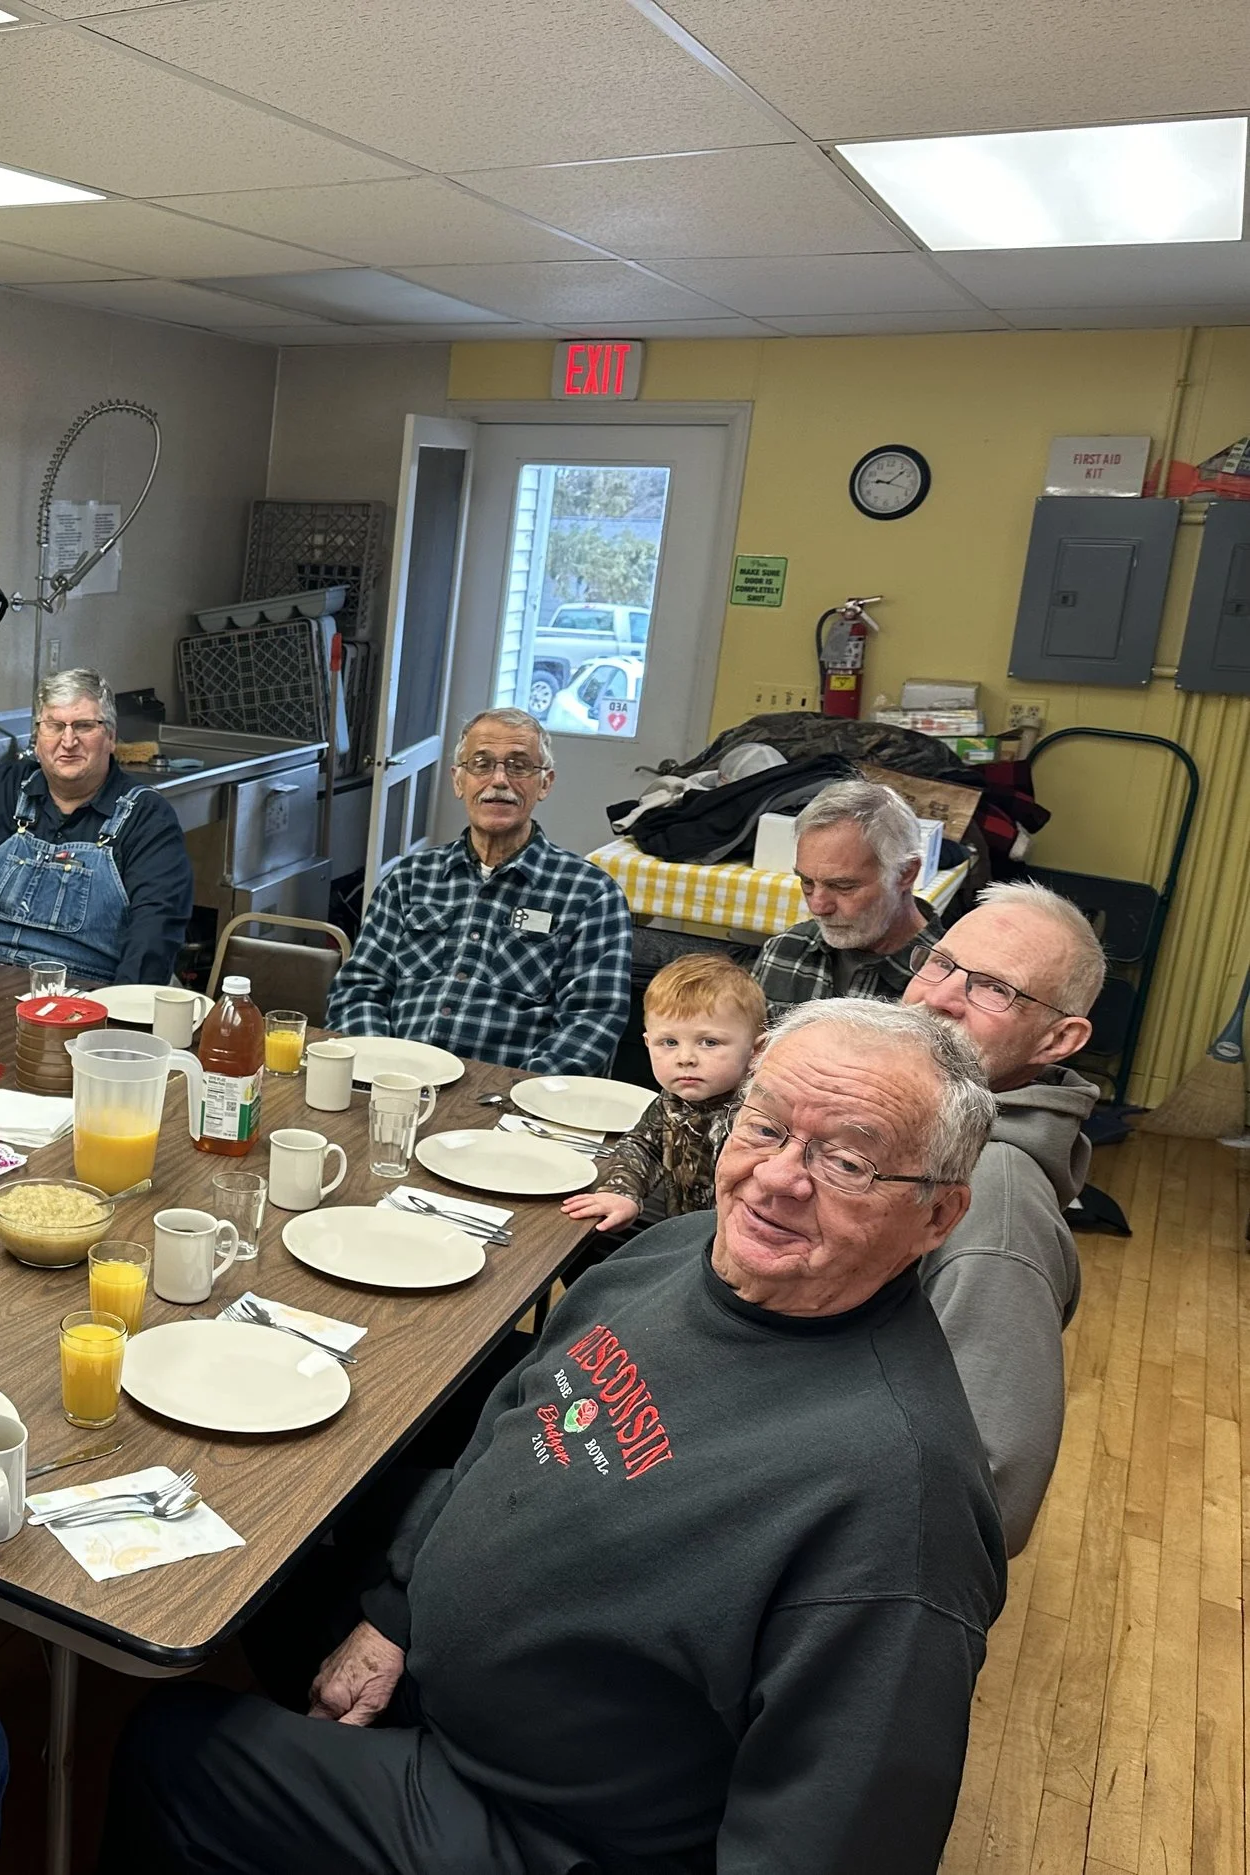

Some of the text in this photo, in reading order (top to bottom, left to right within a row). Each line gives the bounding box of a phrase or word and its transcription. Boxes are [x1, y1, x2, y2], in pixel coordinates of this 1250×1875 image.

[564, 344, 631, 395] EXIT
[1073, 453, 1121, 465] FIRST AID
[1084, 468, 1105, 479] KIT
[739, 568, 781, 577] MAKE SURE
[735, 585, 780, 594] COMPLETELY
[747, 594, 766, 602] SHUT
[554, 1368, 573, 1399] ROSE
[532, 1433, 550, 1465] 2000
[584, 1438, 610, 1473] BOWL
